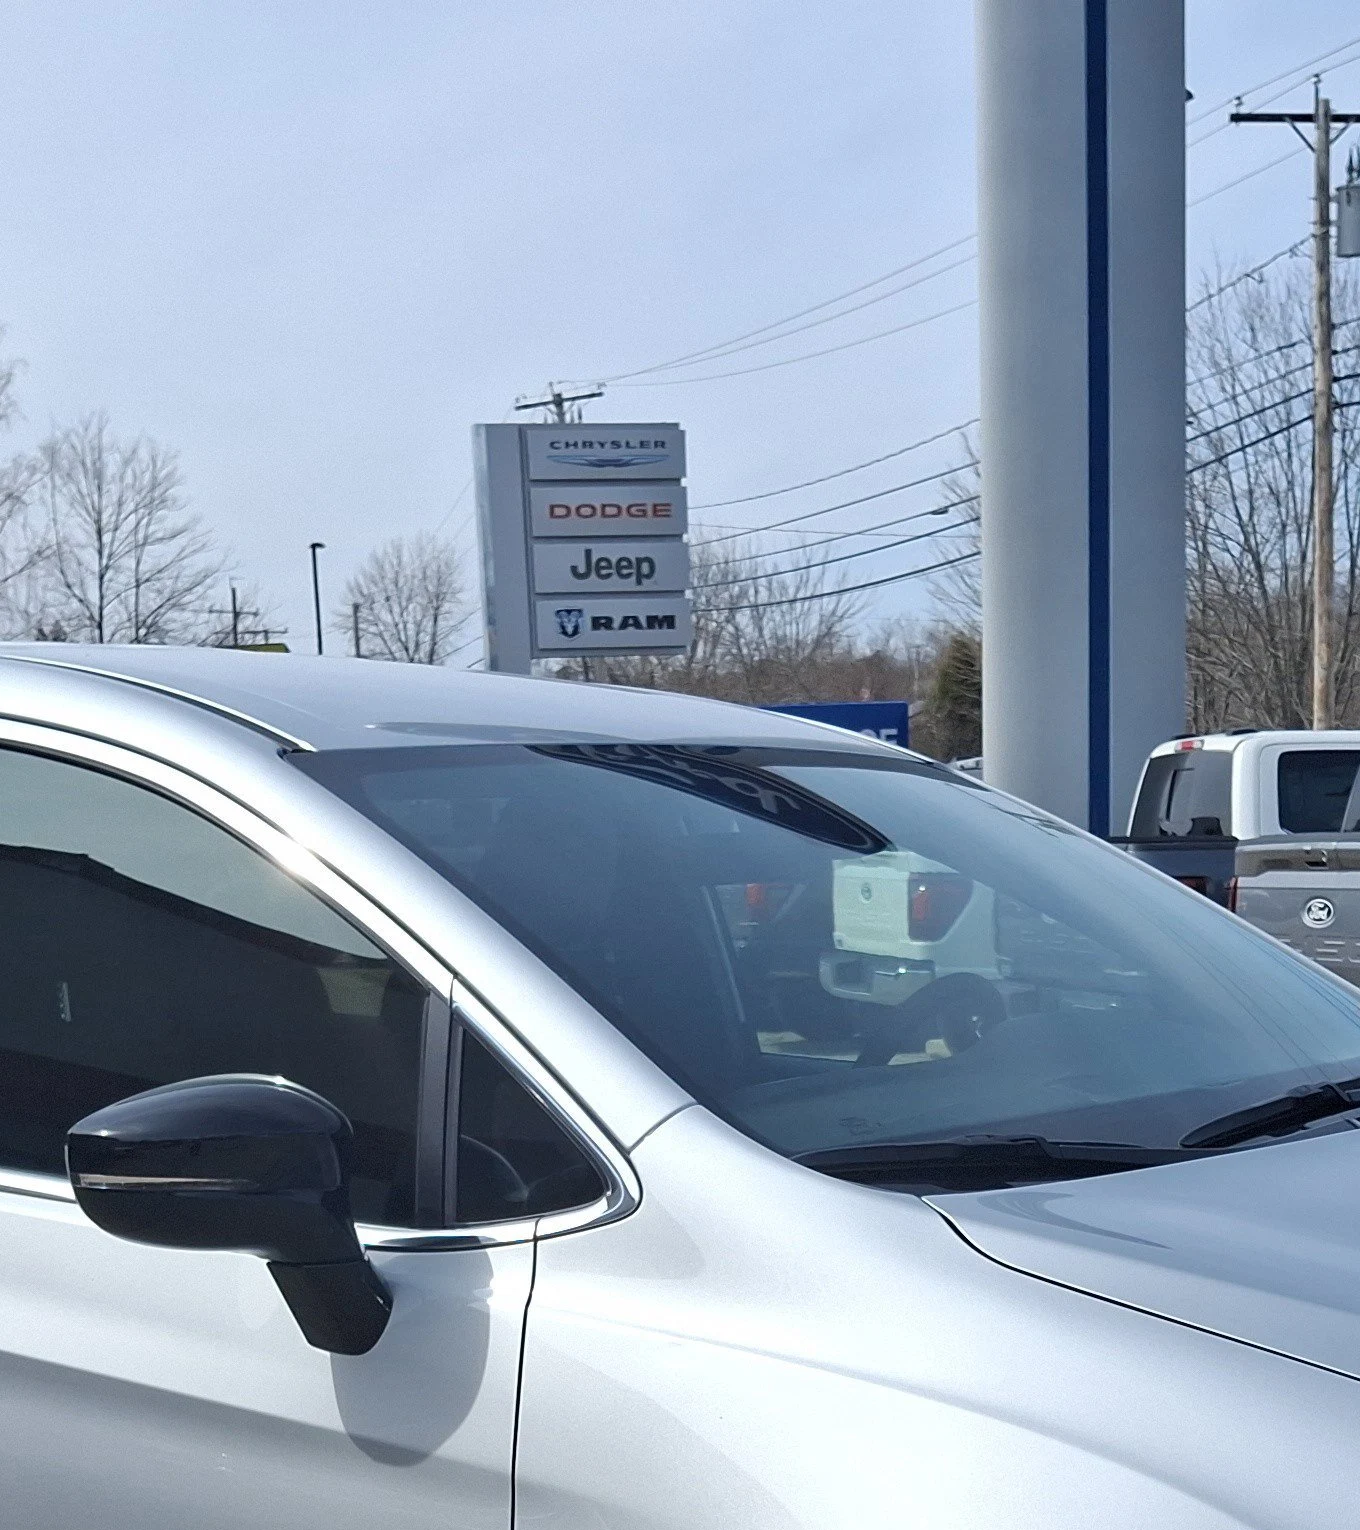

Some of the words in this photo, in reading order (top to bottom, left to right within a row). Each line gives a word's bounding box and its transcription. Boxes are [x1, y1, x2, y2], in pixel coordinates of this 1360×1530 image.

[548, 439, 667, 450] CHRYSLER
[548, 503, 673, 519] DODGE
[570, 548, 656, 586] Jeep
[590, 614, 677, 631] RAM
